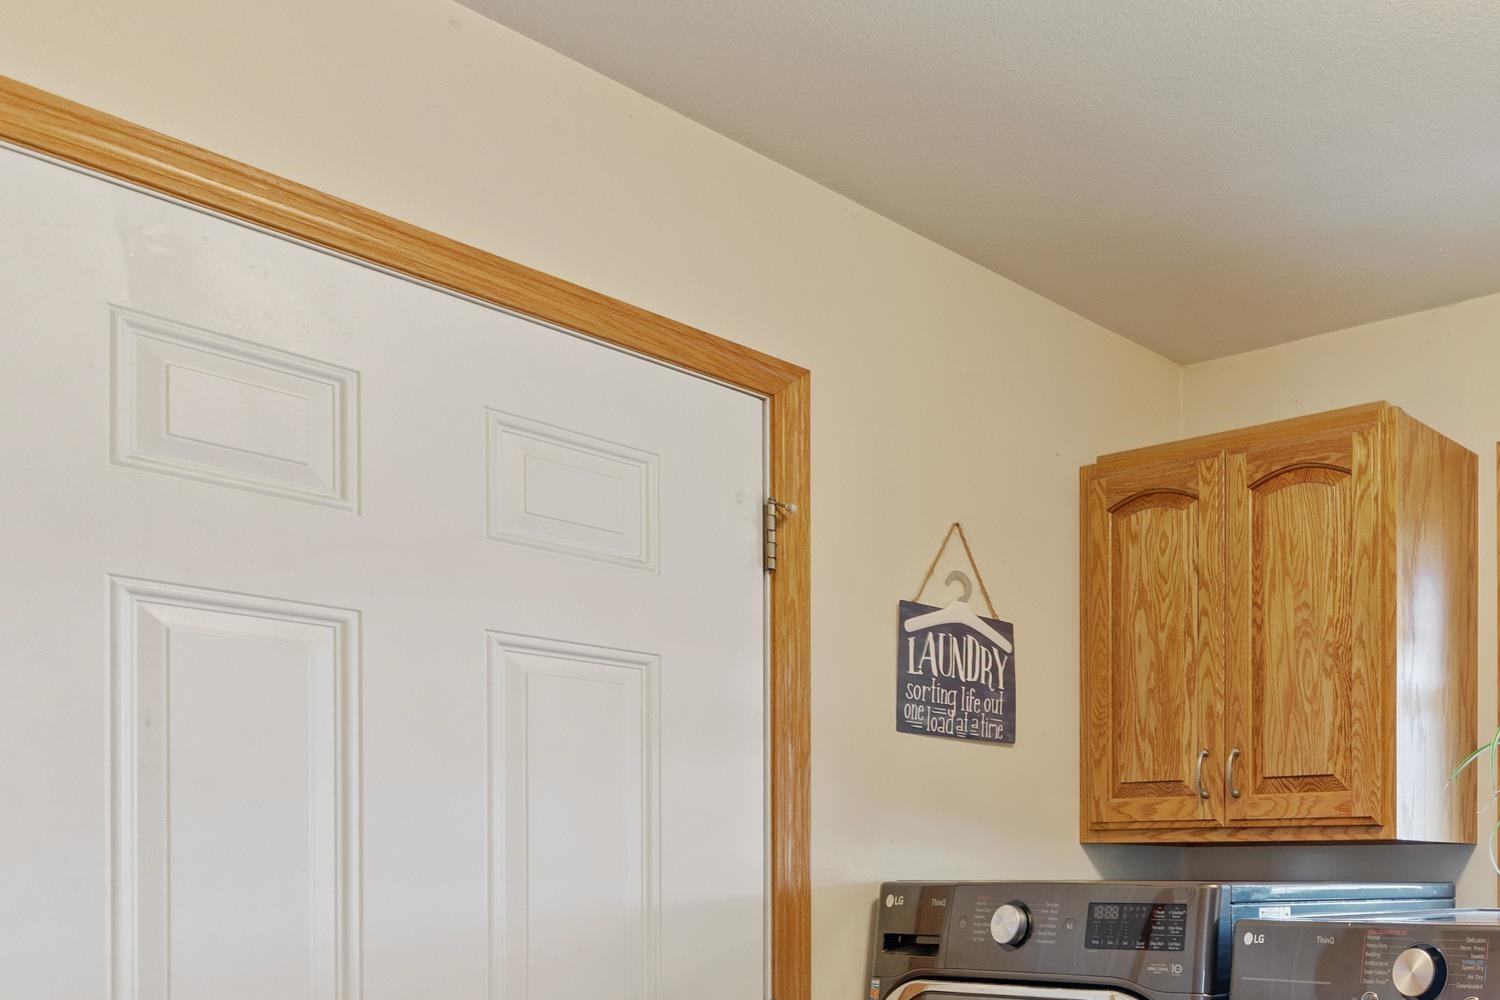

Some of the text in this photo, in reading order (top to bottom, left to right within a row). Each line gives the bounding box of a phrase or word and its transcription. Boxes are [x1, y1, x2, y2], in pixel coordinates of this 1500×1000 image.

[906, 632, 1009, 691] LAUNDRY
[905, 678, 1005, 717] sorting life out
[904, 703, 1004, 740] one load at a time
[1253, 934, 1265, 944] LG
[1316, 935, 1336, 945] ThinQ
